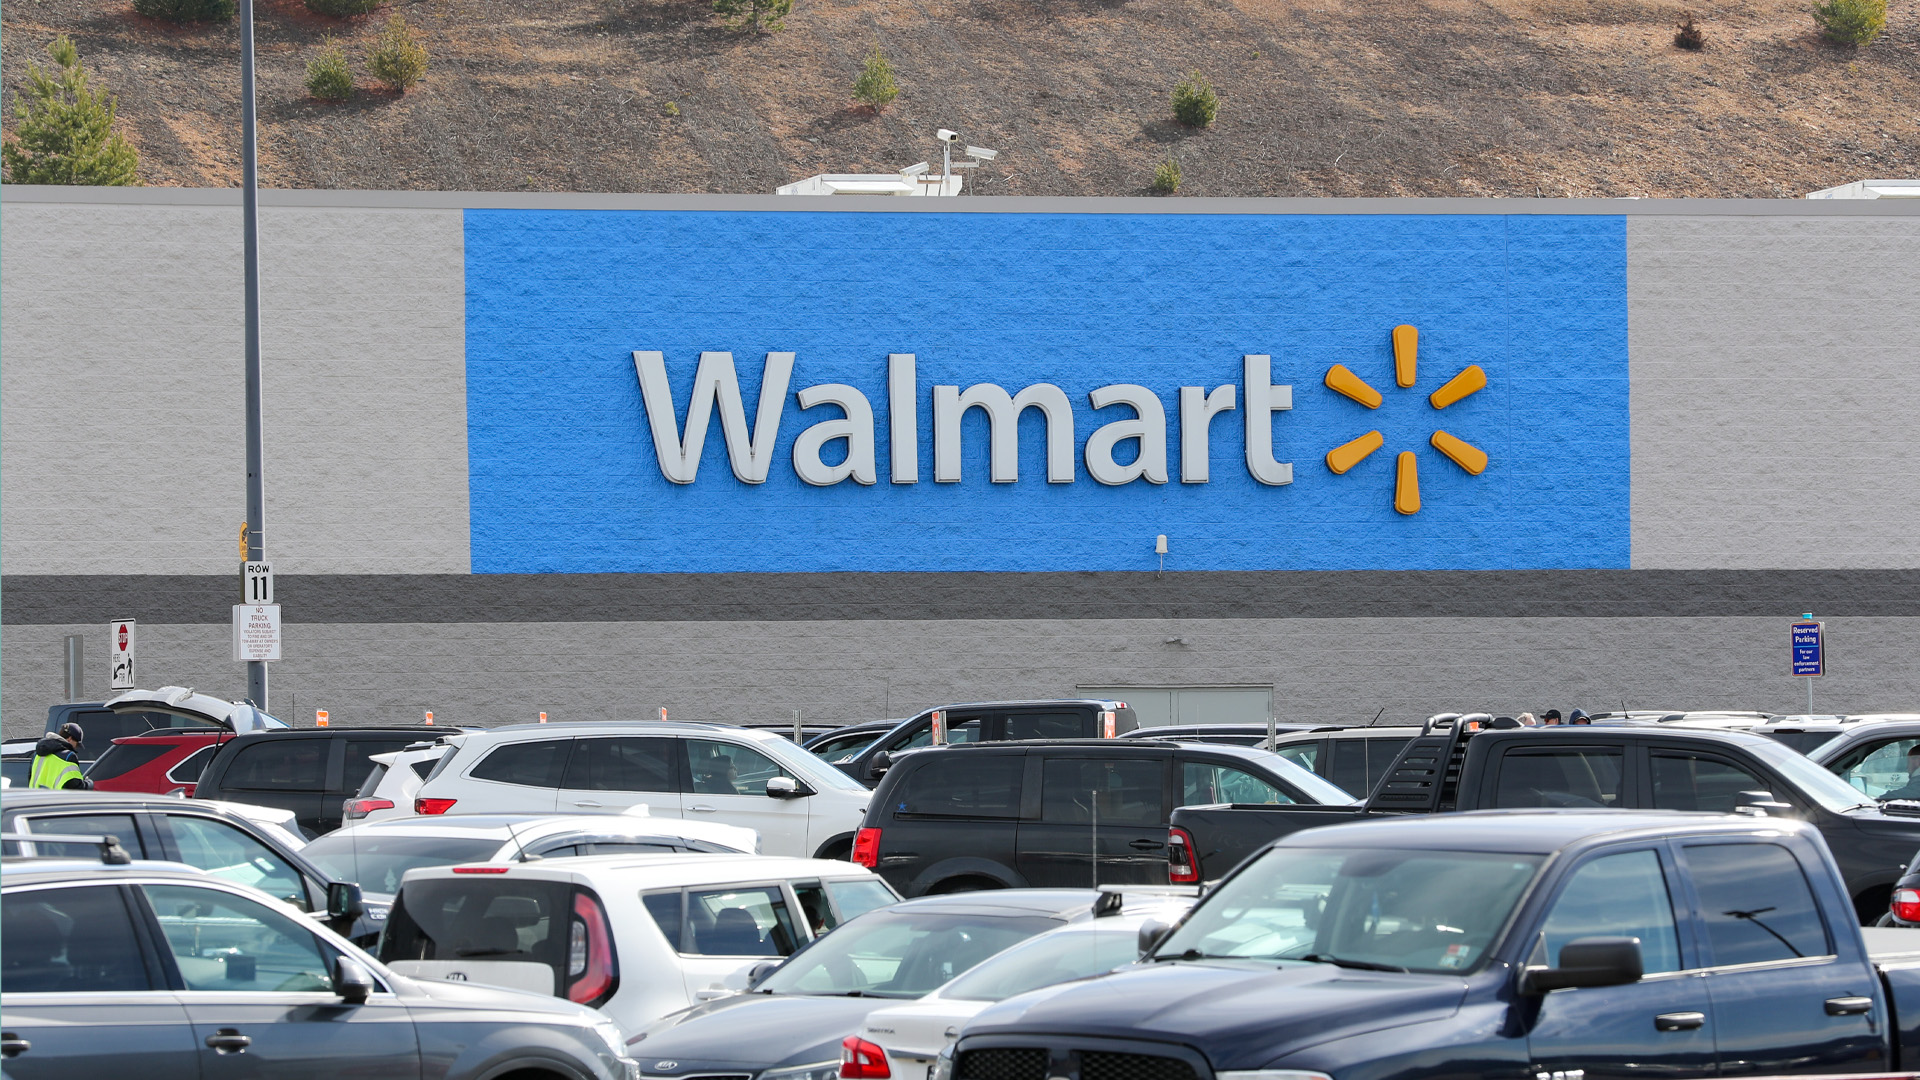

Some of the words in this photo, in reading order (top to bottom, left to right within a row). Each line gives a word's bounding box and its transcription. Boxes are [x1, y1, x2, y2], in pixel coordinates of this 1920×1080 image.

[631, 350, 1293, 486] Walmart
[247, 565, 270, 573] ROW
[251, 576, 267, 600] 11
[1793, 626, 1818, 634] Reserved
[118, 633, 128, 643] STOP
[1795, 635, 1816, 644] Parking
